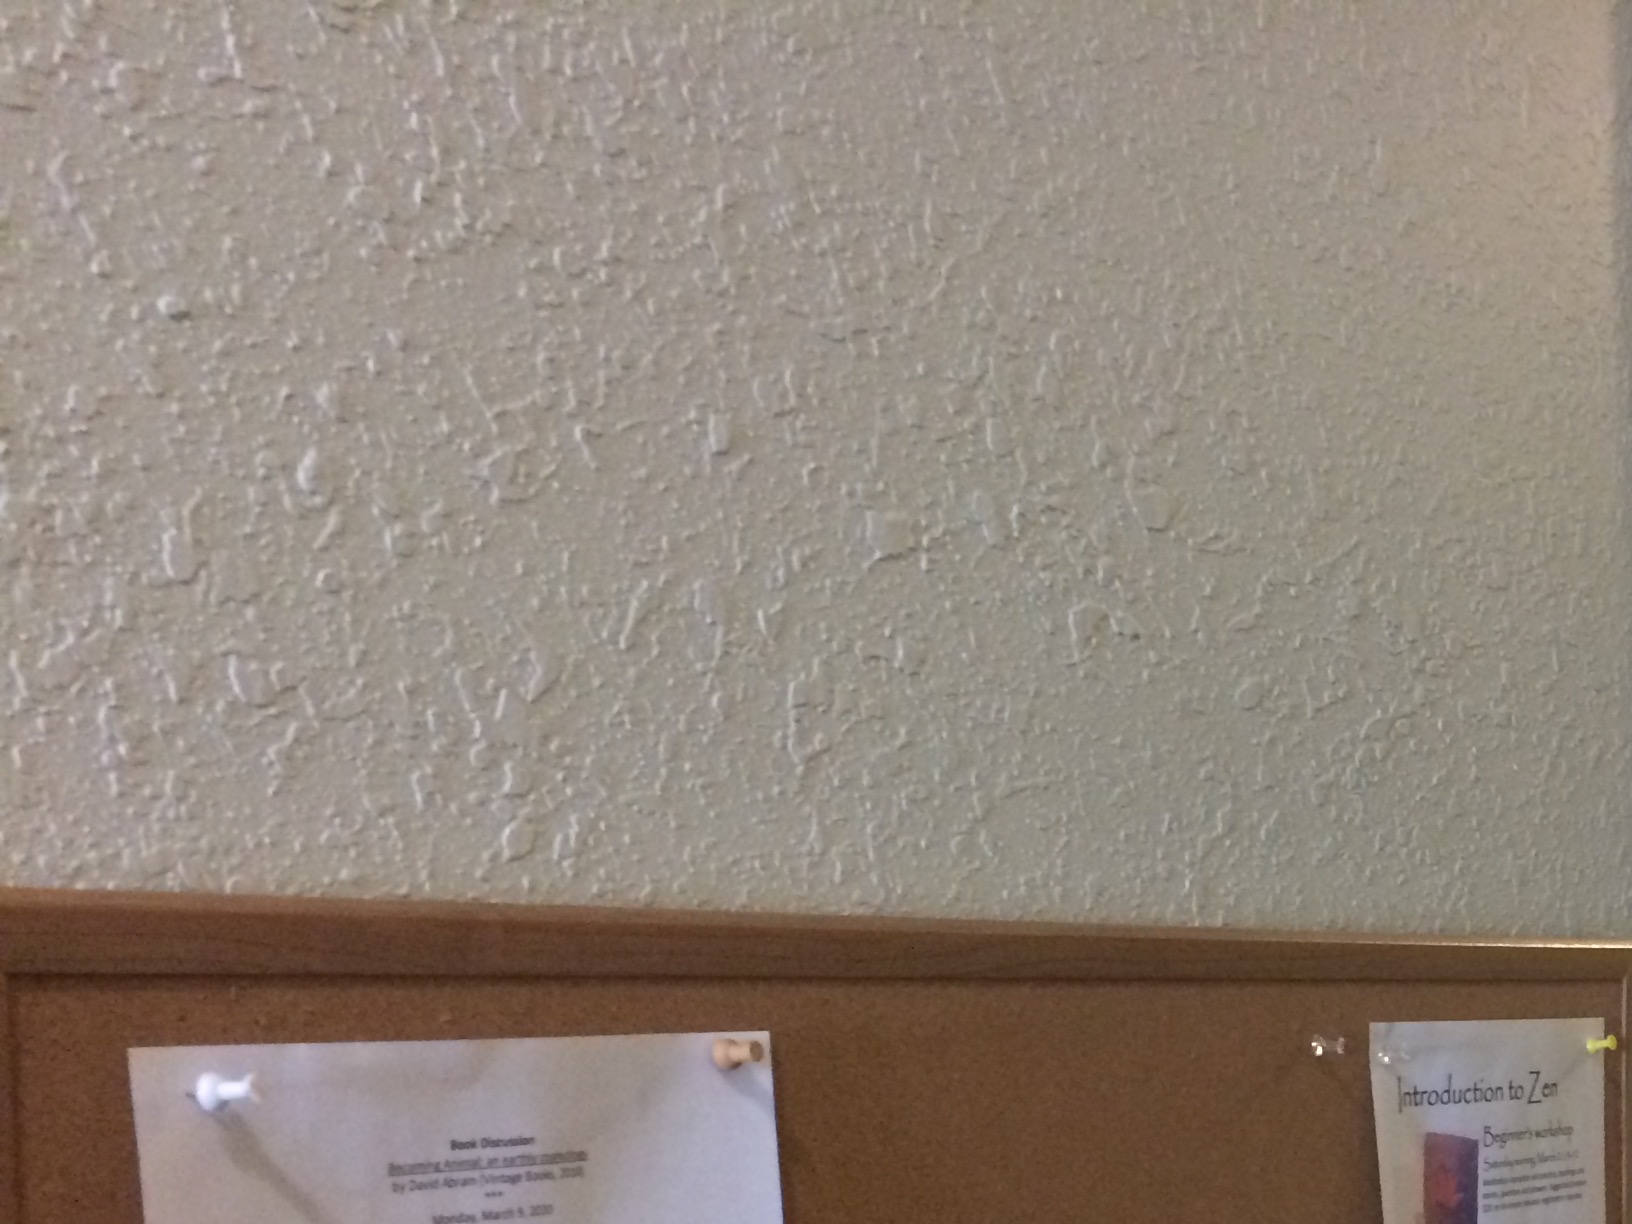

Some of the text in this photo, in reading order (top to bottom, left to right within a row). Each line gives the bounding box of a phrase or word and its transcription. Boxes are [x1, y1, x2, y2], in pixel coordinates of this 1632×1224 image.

[1397, 1070, 1558, 1113] Introduction to Zen
[479, 1136, 536, 1149] Discussion
[1483, 1118, 1574, 1149] Beginner's workshop
[391, 1181, 407, 1195] by
[408, 1179, 441, 1192] David
[441, 1177, 478, 1189] Abram
[481, 1208, 515, 1221] March
